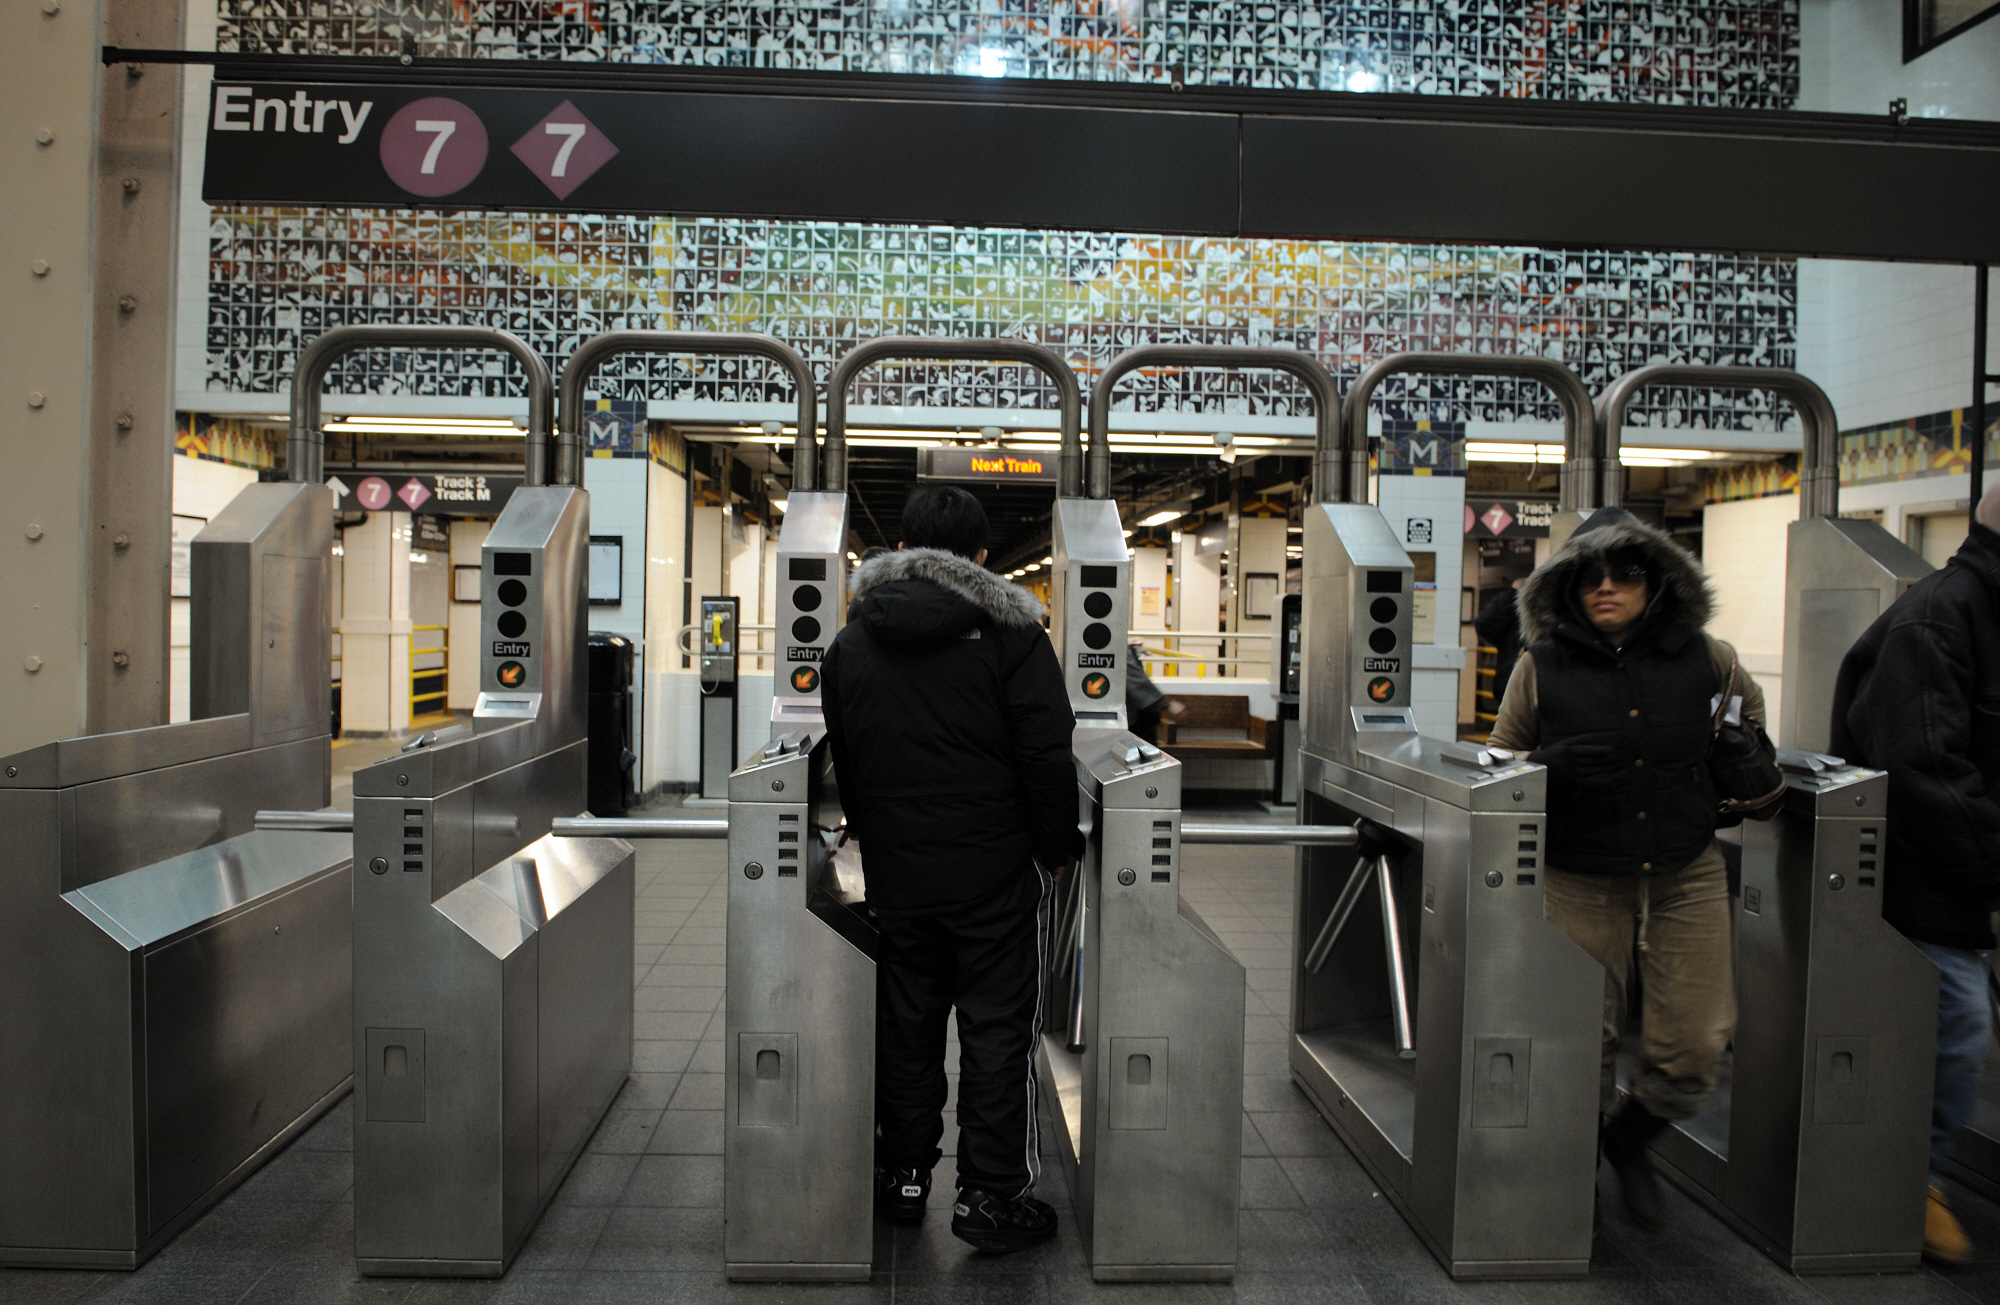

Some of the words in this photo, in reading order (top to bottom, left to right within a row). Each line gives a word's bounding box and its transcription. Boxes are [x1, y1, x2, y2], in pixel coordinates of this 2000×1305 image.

[213, 86, 372, 144] Entry
[414, 119, 456, 175] 7
[545, 122, 586, 178] 7
[588, 420, 619, 447] M
[1408, 439, 1438, 465] M
[971, 457, 1005, 473] Next
[1005, 458, 1042, 474] Train
[434, 475, 475, 488] Track
[476, 476, 486, 488] 2
[367, 483, 382, 503] 7
[407, 484, 421, 503] 7
[434, 487, 475, 501] Track
[476, 488, 491, 501] M
[1516, 501, 1554, 514] Track
[1489, 509, 1504, 529] 7
[494, 643, 529, 656] Entry
[788, 648, 823, 662] Entry
[1079, 654, 1113, 668] Entry
[1365, 659, 1399, 672] Entry
